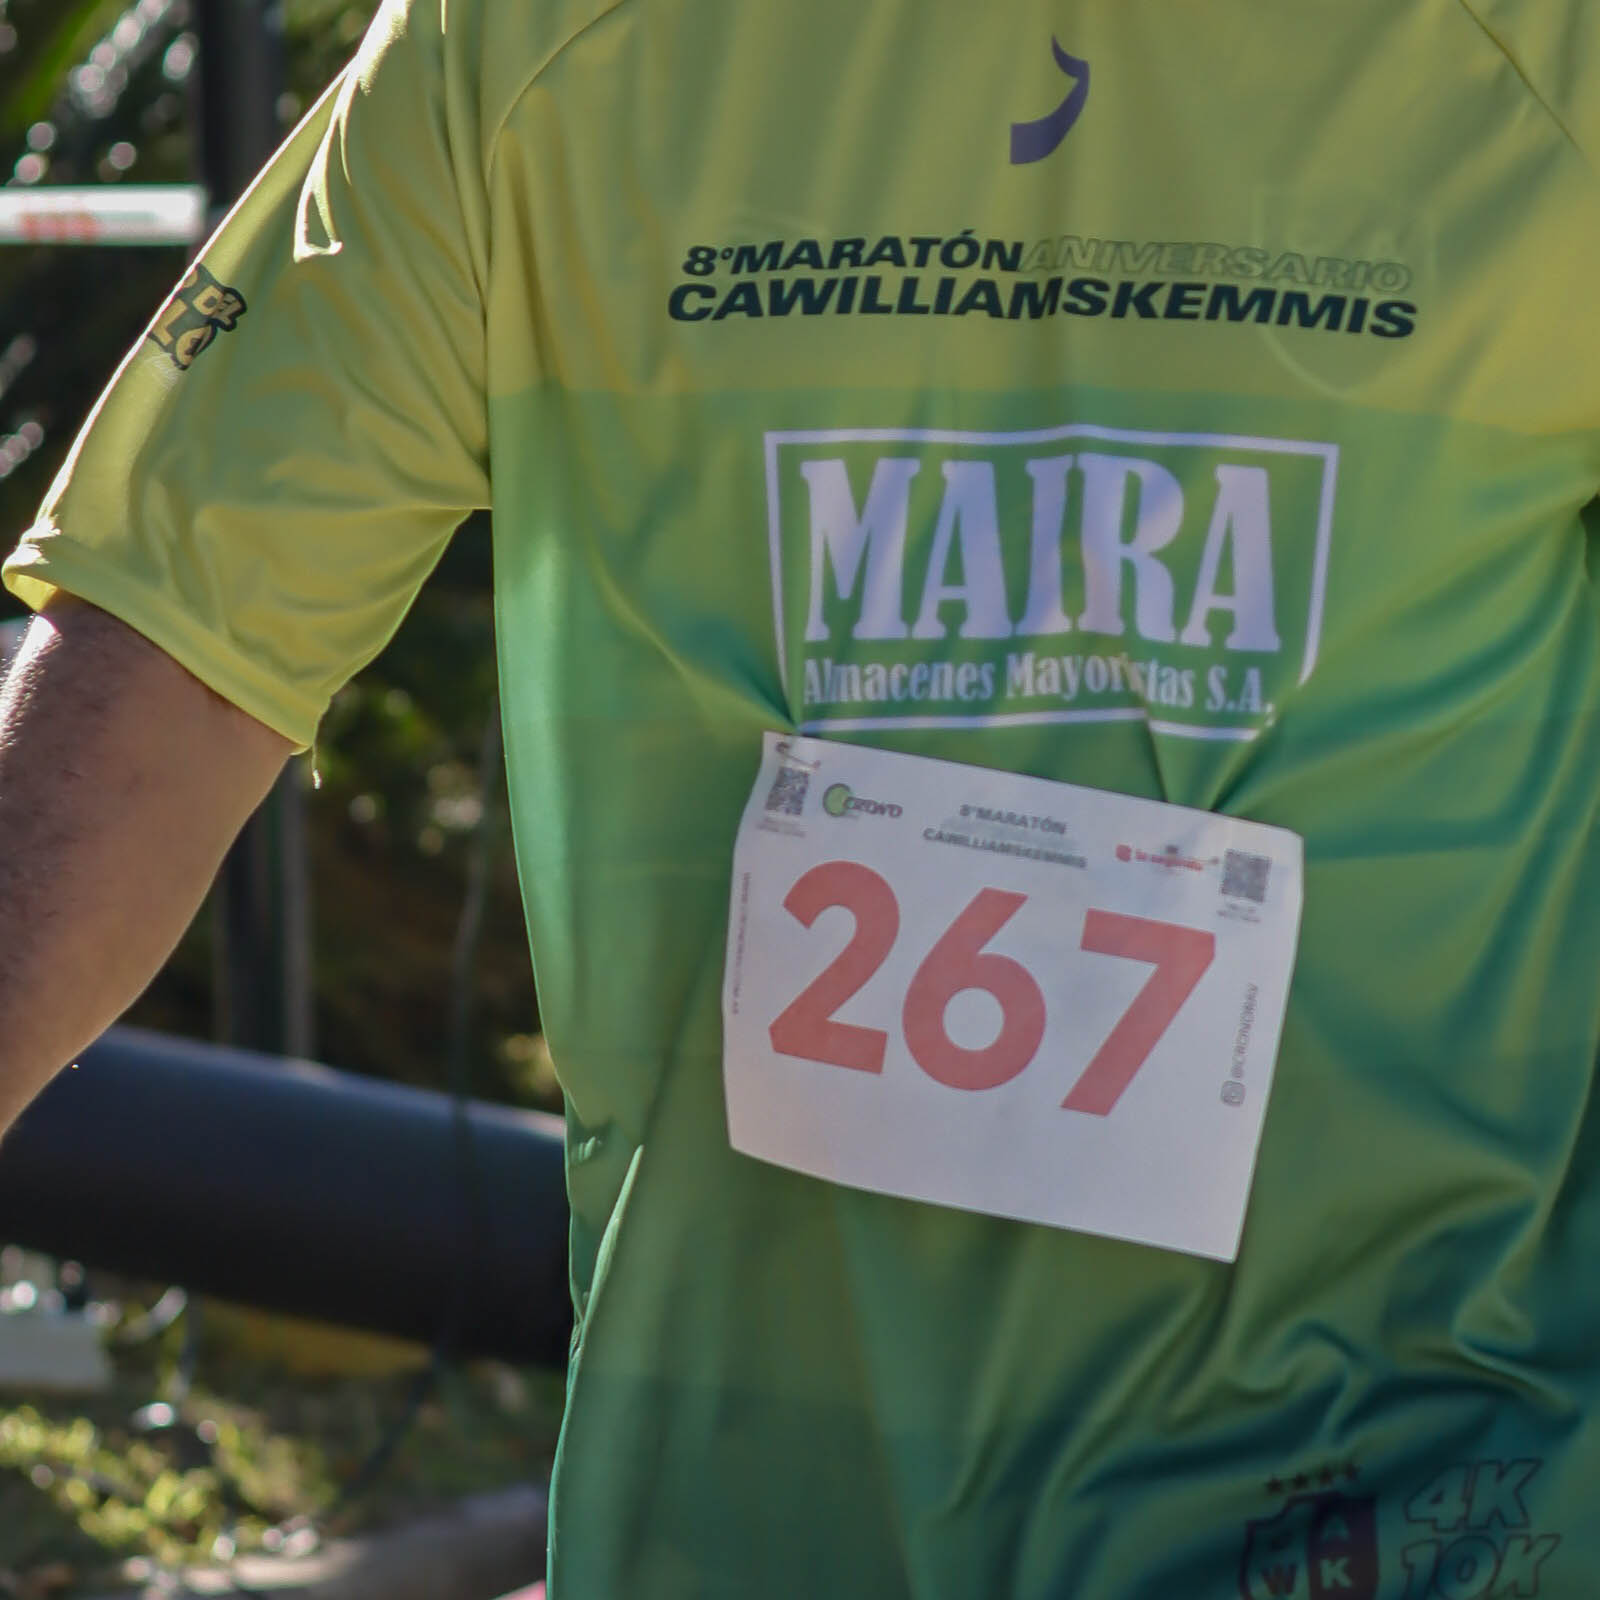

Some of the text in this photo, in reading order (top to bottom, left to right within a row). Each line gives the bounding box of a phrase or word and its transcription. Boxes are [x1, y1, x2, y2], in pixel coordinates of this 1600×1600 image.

[1023, 234, 1412, 293] ANIVERSARIO
[668, 276, 1418, 338] CAWILLIAMSKEMMIS
[801, 452, 1282, 652] MAIRA
[803, 656, 995, 705] Almacenes
[768, 860, 1217, 1117] 267
[1404, 1458, 1544, 1534] 4K
